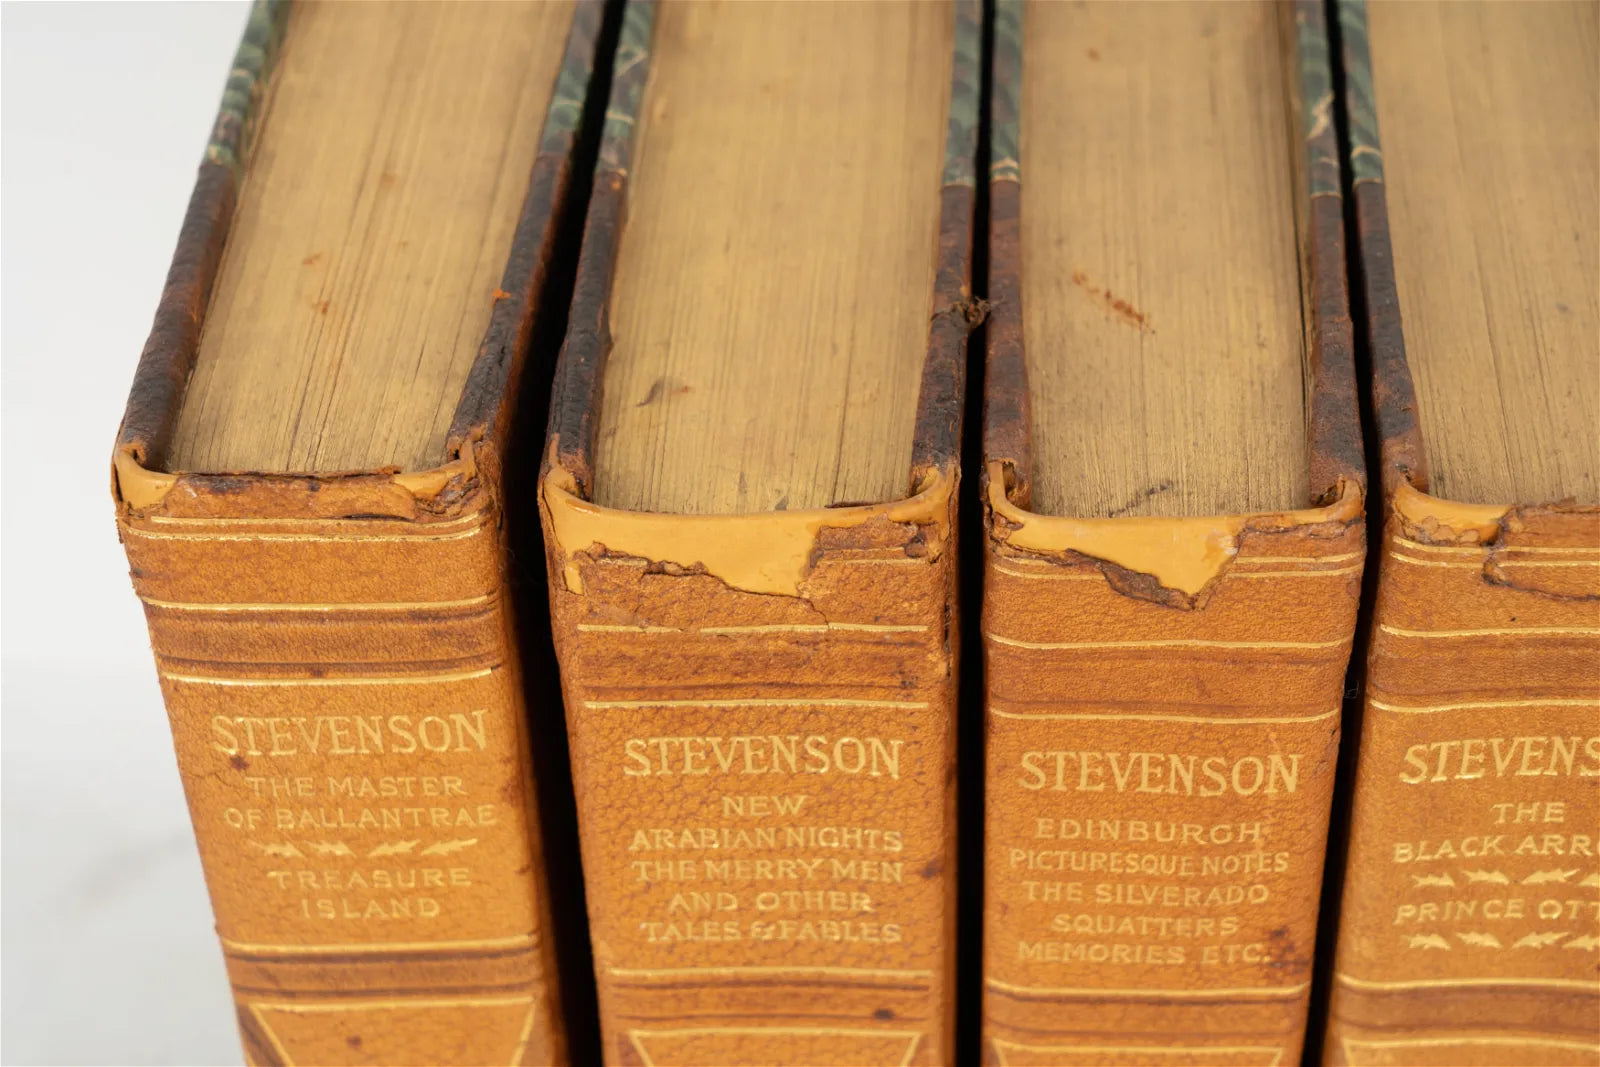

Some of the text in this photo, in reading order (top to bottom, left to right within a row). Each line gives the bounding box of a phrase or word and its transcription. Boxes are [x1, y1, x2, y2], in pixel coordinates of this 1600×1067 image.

[211, 709, 488, 756] STEVENSON
[623, 735, 904, 780] STEVENSON
[244, 774, 469, 798] THE MASTER
[1019, 751, 1301, 798] STEVENSON
[223, 803, 498, 830] OF BALLANTRAE
[721, 795, 808, 817] NEW
[1489, 802, 1566, 825] THE
[628, 827, 904, 852] ARABIAN NIGHTS
[1034, 818, 1263, 845] EDINBURGH
[1391, 834, 1600, 864] BLACK ARR
[631, 859, 904, 883] THE MERRY MEN
[1008, 848, 1290, 876] PICTURESQUE NOTES
[266, 867, 473, 890] TREASURE
[667, 890, 874, 913] AND OTHER
[1022, 880, 1270, 908] THE SILVERADO
[302, 897, 441, 920] ISLAND
[1391, 899, 1526, 926] PRINCE
[639, 920, 742, 943] TALES
[778, 919, 903, 944] FABLES
[1051, 913, 1240, 937] SQUATTERS
[1015, 940, 1272, 965] MEMORIES ETC.
